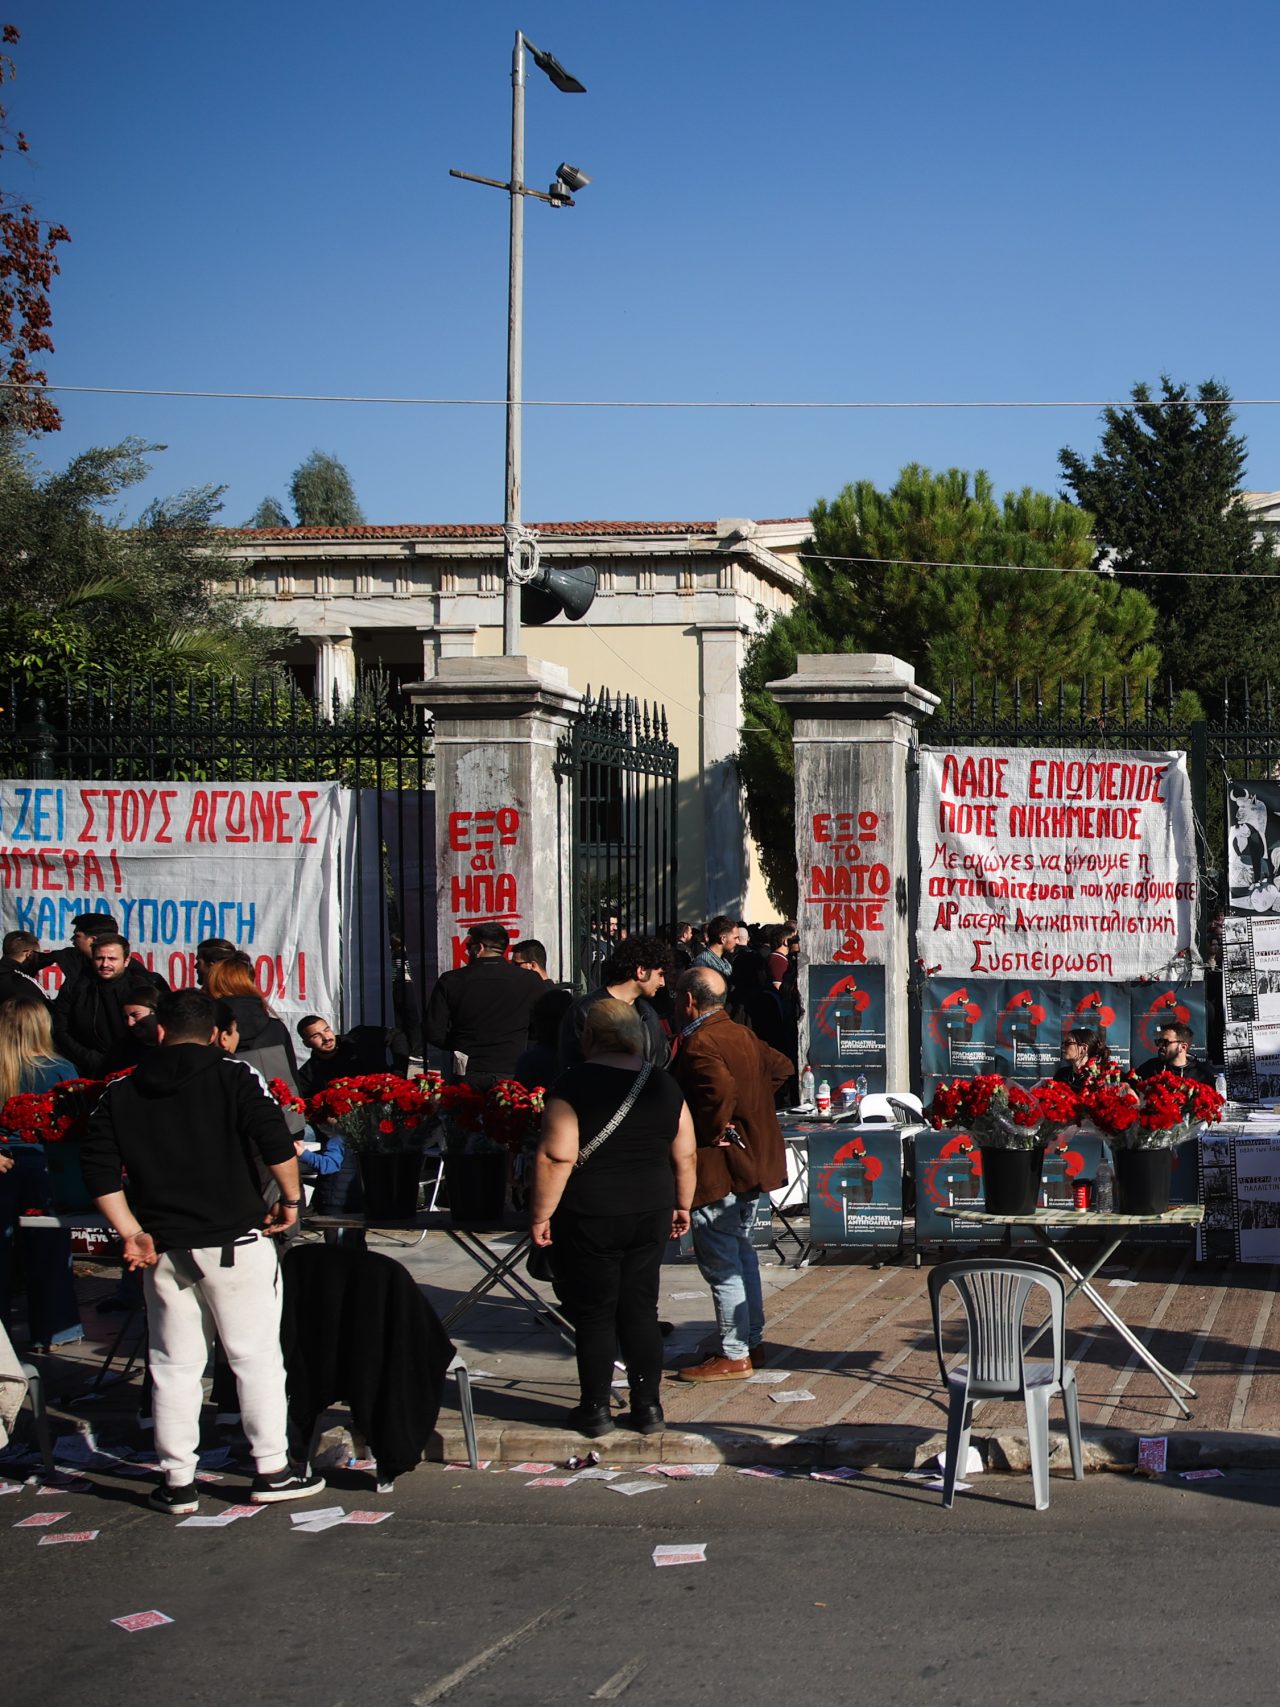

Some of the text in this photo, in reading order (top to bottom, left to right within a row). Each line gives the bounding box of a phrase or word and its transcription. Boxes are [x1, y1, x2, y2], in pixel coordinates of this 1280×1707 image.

[941, 754, 1169, 804] ΛΑΟΣ ΕΝΩΜΕΝΟΣ
[12, 788, 319, 844] ΖΕΙ ΣΤΟΥΣ ΑΓΩΝΕΣ
[448, 807, 520, 851] ΕΞΩ
[813, 811, 879, 842] ΕΞΩ
[939, 800, 1143, 840] ΠΟΤΕ ΝΙΚΗΜΕΝΟΣ
[829, 844, 861, 862] ΤΟ
[928, 842, 960, 870] Με
[963, 846, 1034, 879] αγώνες
[1040, 854, 1061, 872] να
[1064, 846, 1129, 877] γίνουμε
[451, 873, 517, 913] ΗΠΑ
[811, 863, 891, 896] ΝΑΤΟ
[1079, 883, 1103, 899] που
[119, 898, 256, 944] ΥΠΟΤΑΓΗ
[822, 903, 884, 930] ΚΝΕ
[970, 939, 1113, 977] Συσπείρωση
